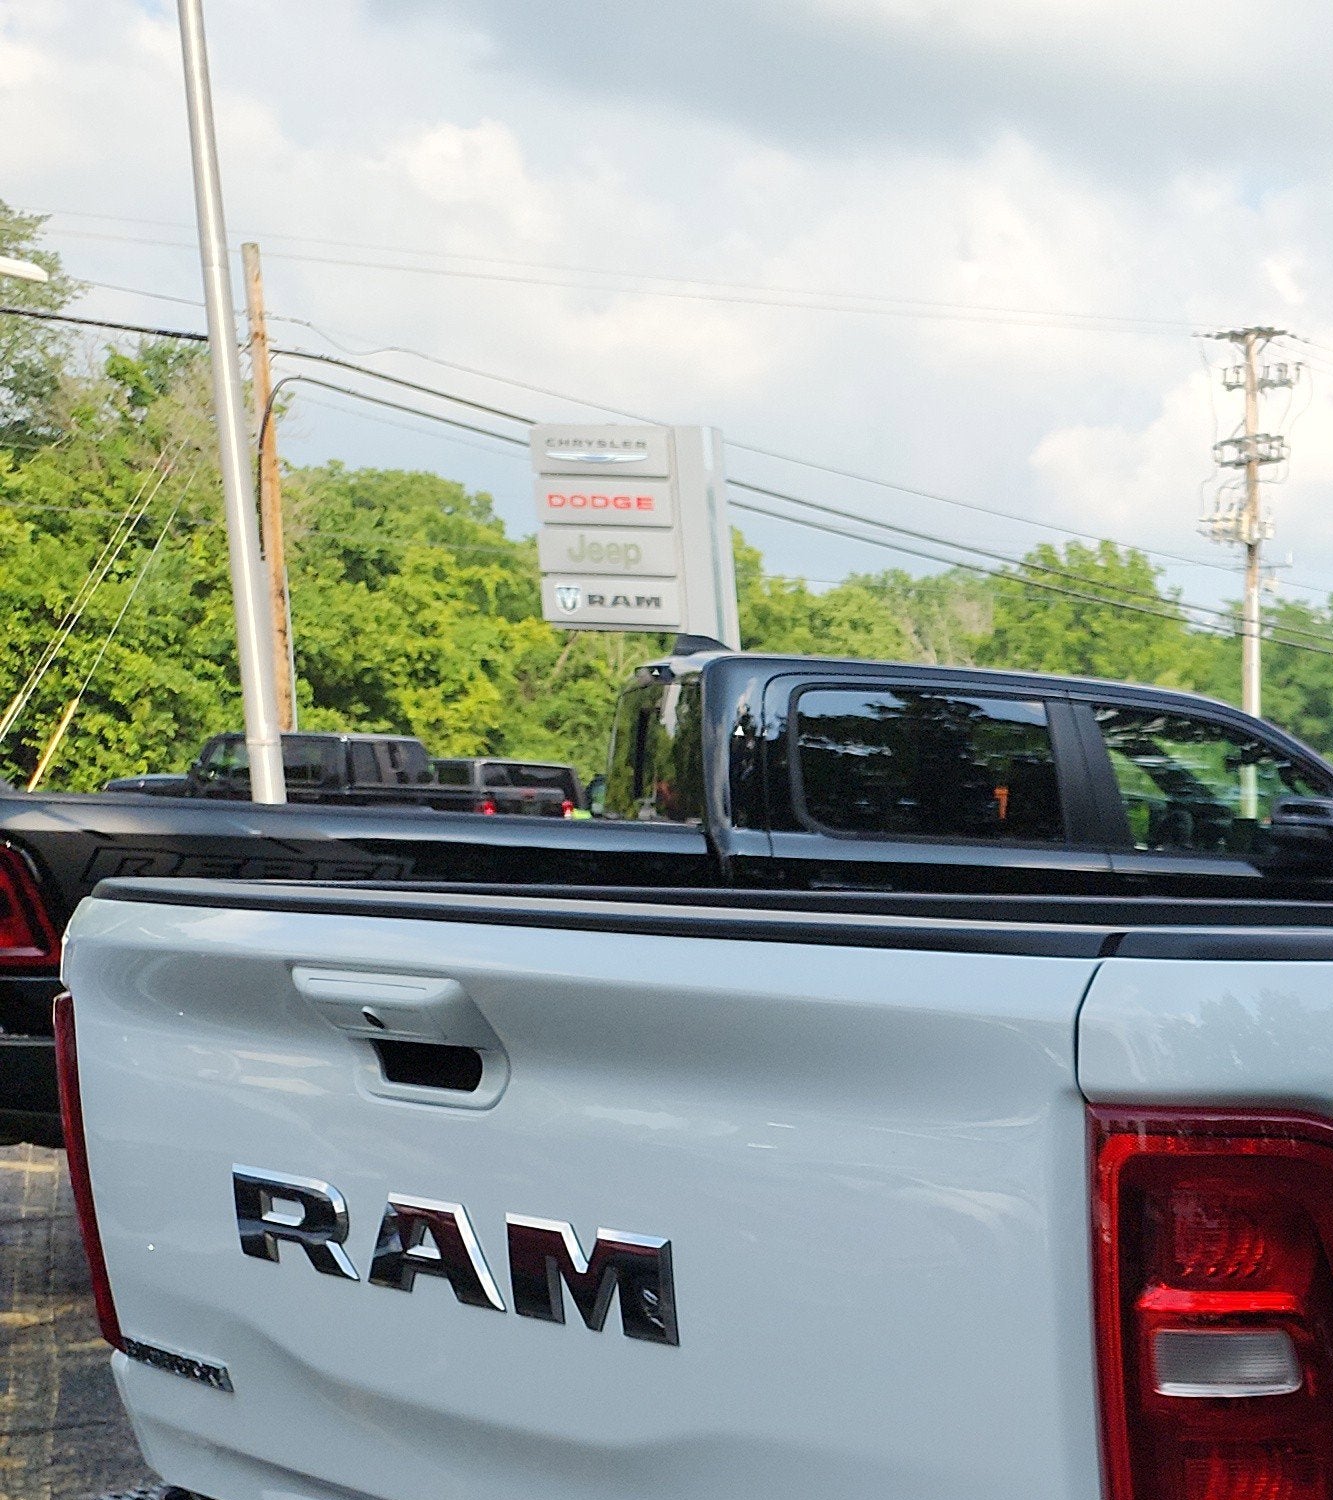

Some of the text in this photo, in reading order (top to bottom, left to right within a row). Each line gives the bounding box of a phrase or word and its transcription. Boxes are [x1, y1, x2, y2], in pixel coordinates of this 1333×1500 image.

[545, 437, 648, 449] CHRYSLER
[547, 494, 655, 511] DODGE
[567, 534, 642, 569] Jeep
[587, 593, 663, 609] RAM
[231, 1162, 681, 1347] RAM
